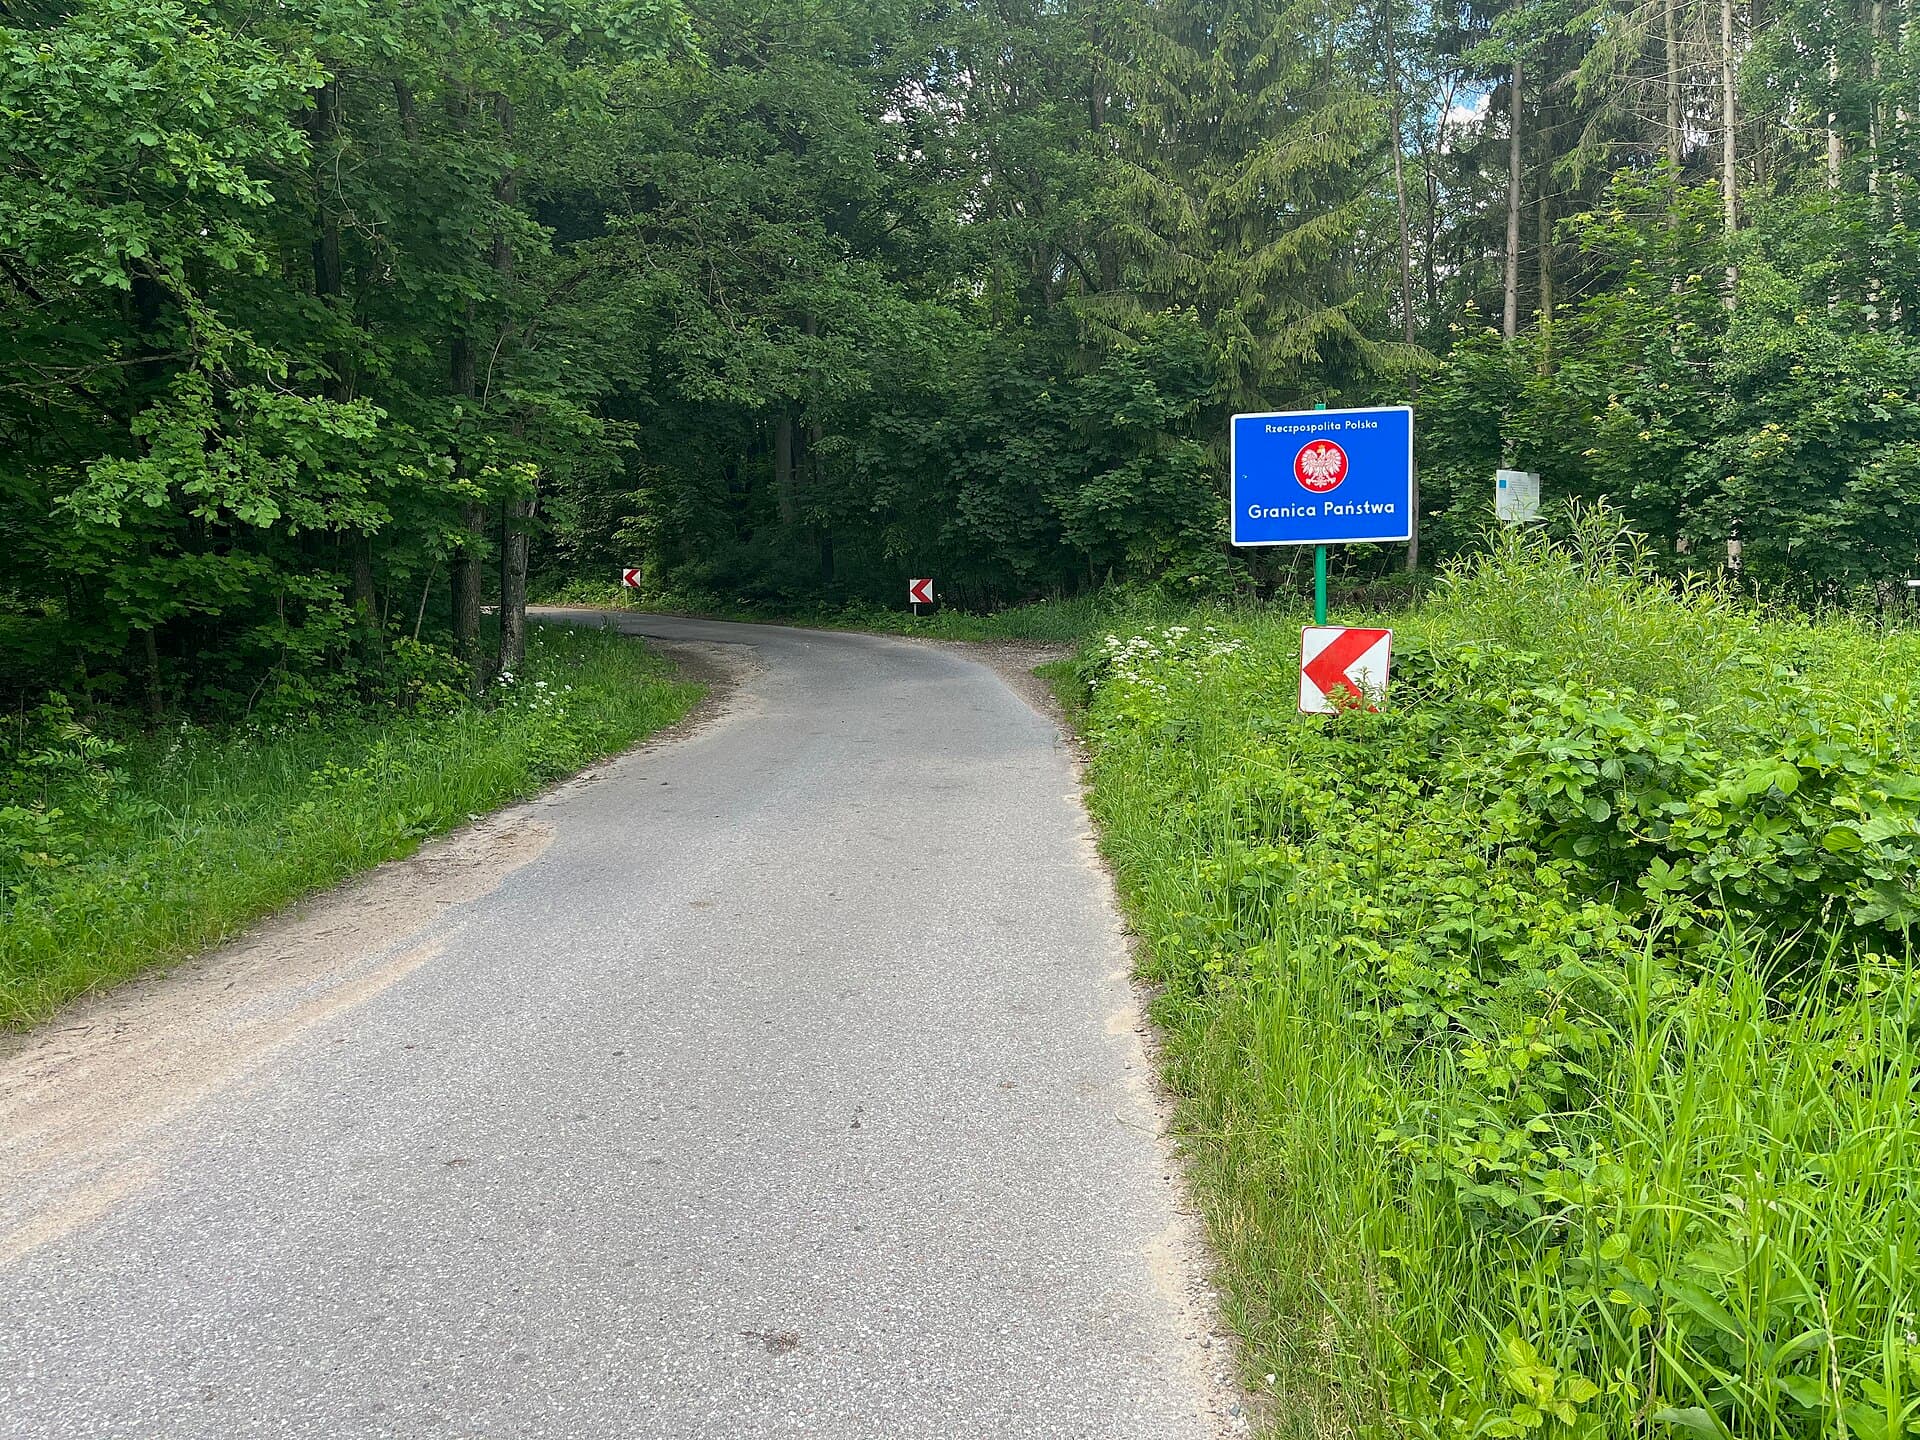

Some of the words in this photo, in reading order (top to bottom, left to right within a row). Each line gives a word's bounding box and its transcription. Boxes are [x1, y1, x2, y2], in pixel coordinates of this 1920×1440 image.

[1265, 422, 1341, 435] Rzeczpospolita
[1345, 420, 1378, 430] Polska
[1248, 503, 1316, 519] Granica
[1324, 500, 1395, 516] Państwa
